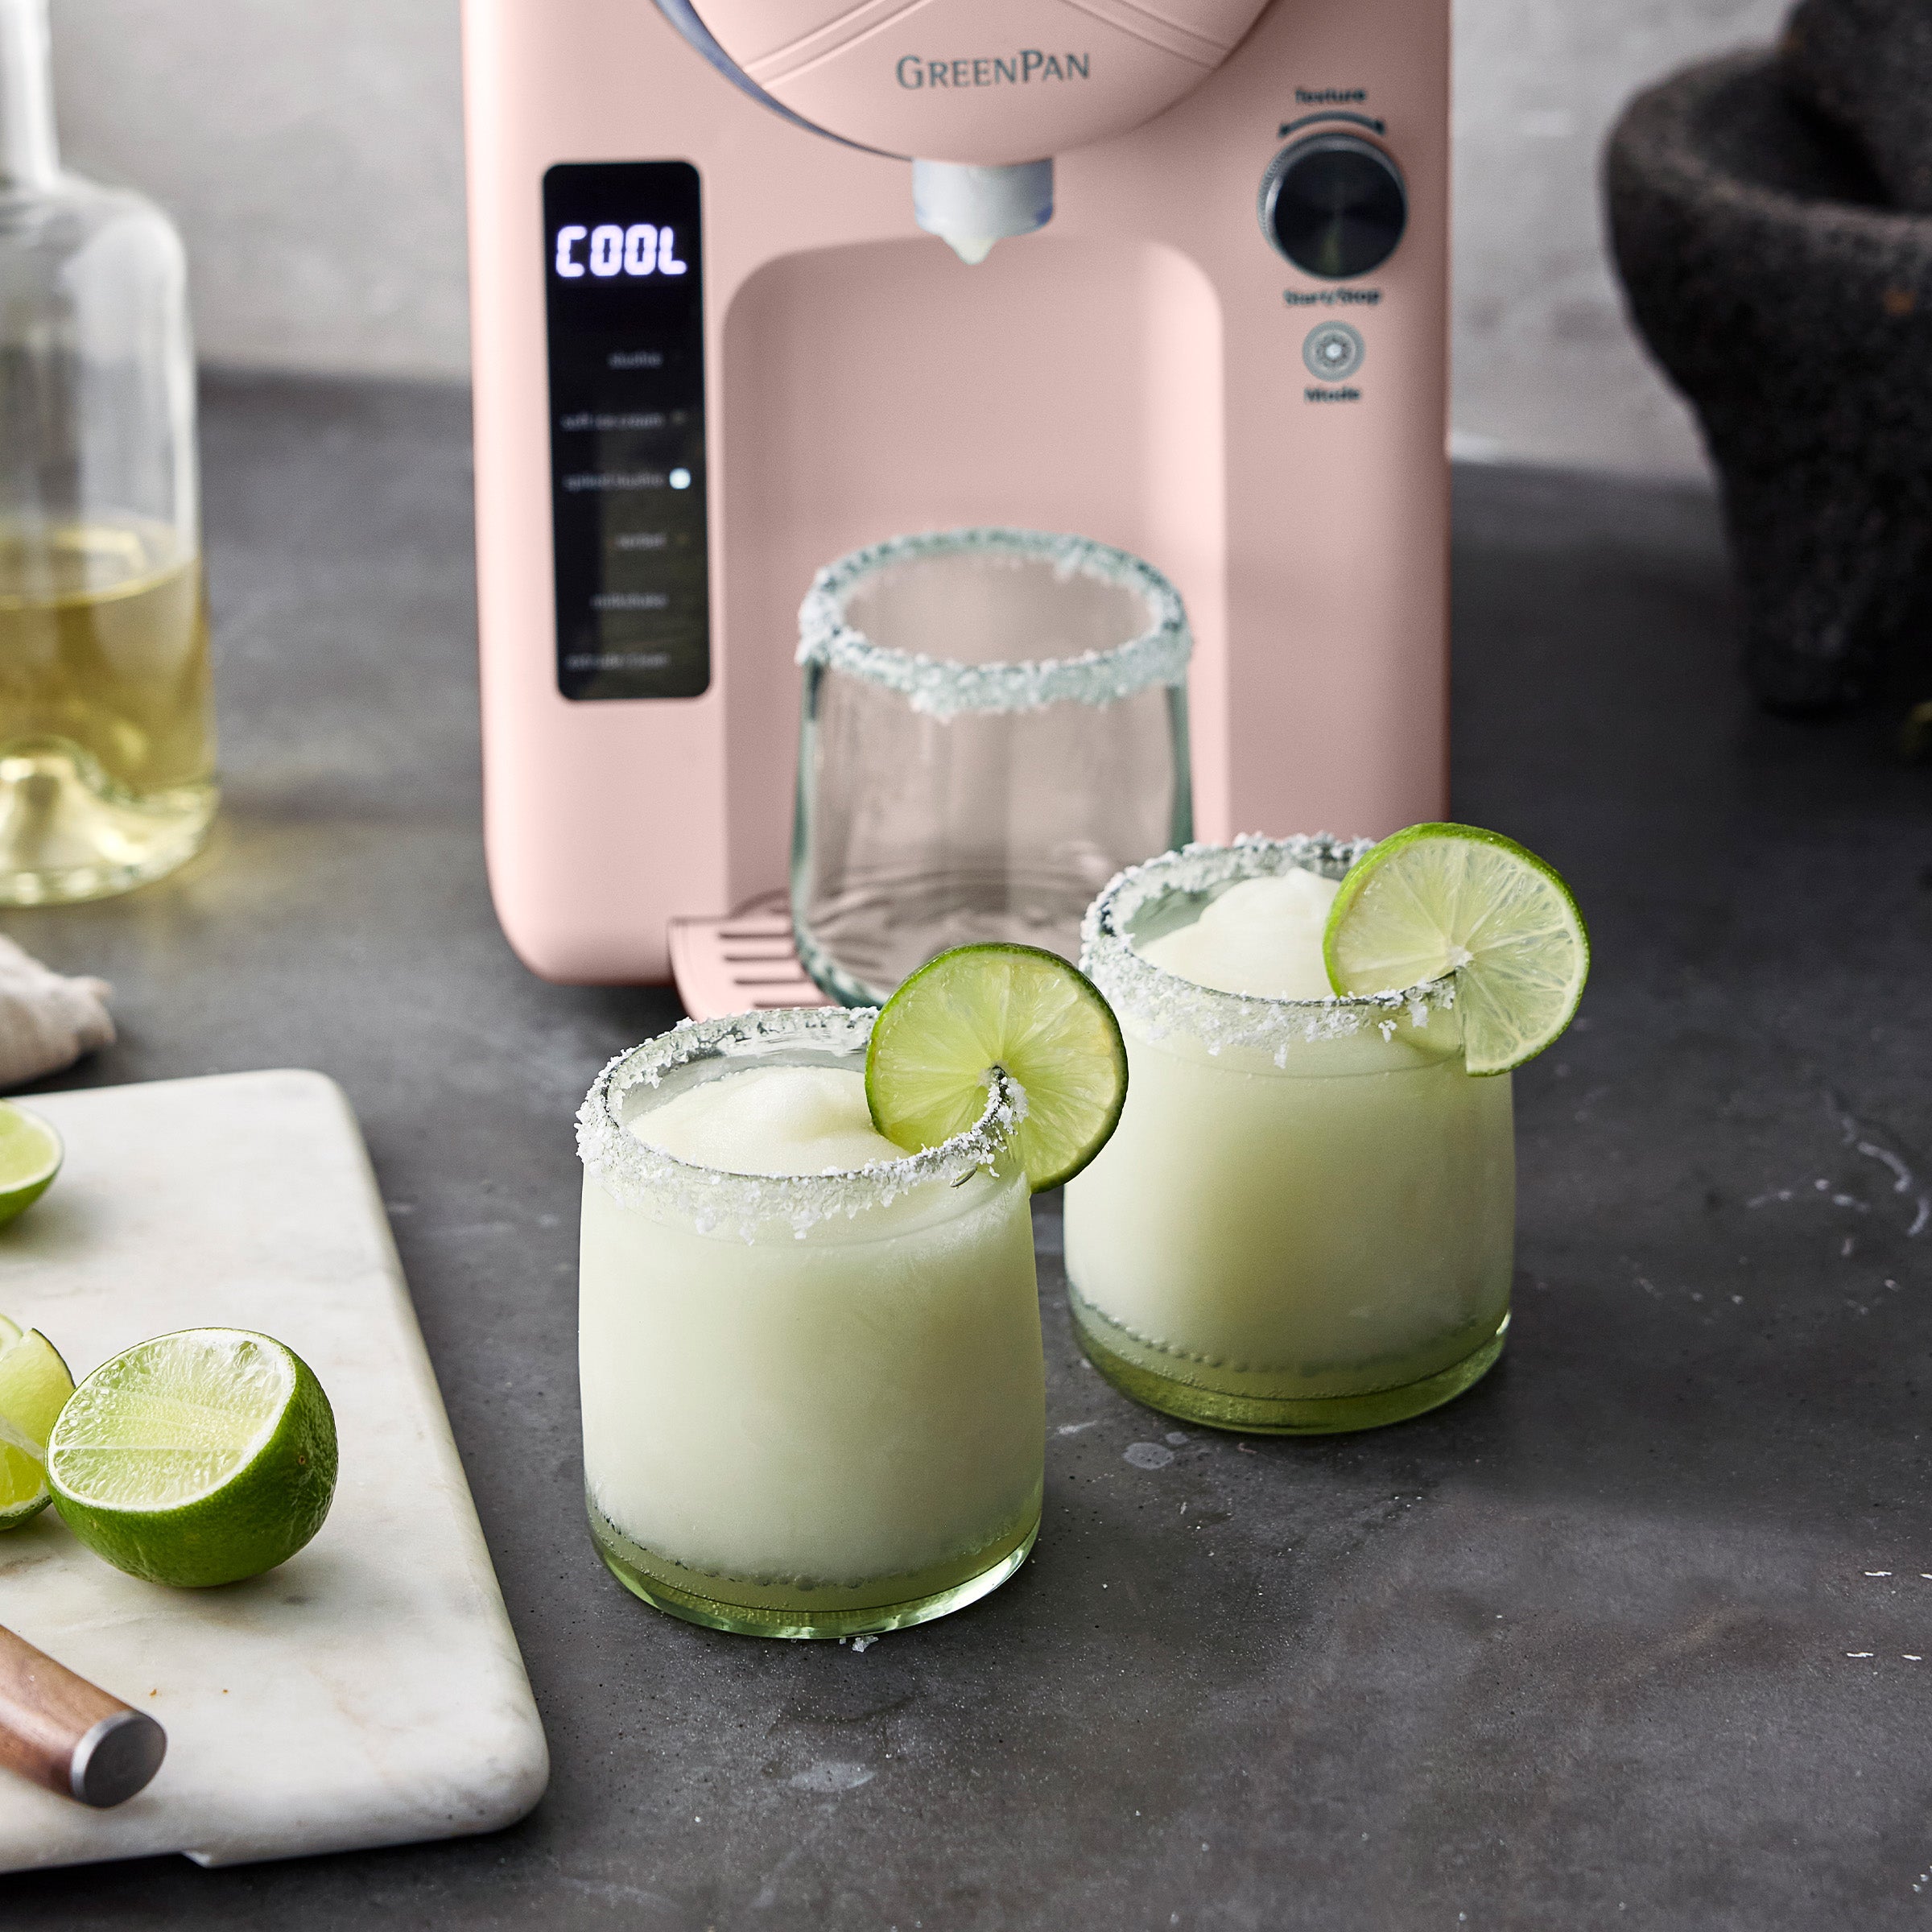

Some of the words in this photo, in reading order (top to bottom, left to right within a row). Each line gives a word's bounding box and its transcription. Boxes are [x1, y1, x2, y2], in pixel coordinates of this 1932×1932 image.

[1294, 88, 1366, 103] Texture
[555, 224, 688, 278] COOL
[1303, 386, 1361, 402] Mode
